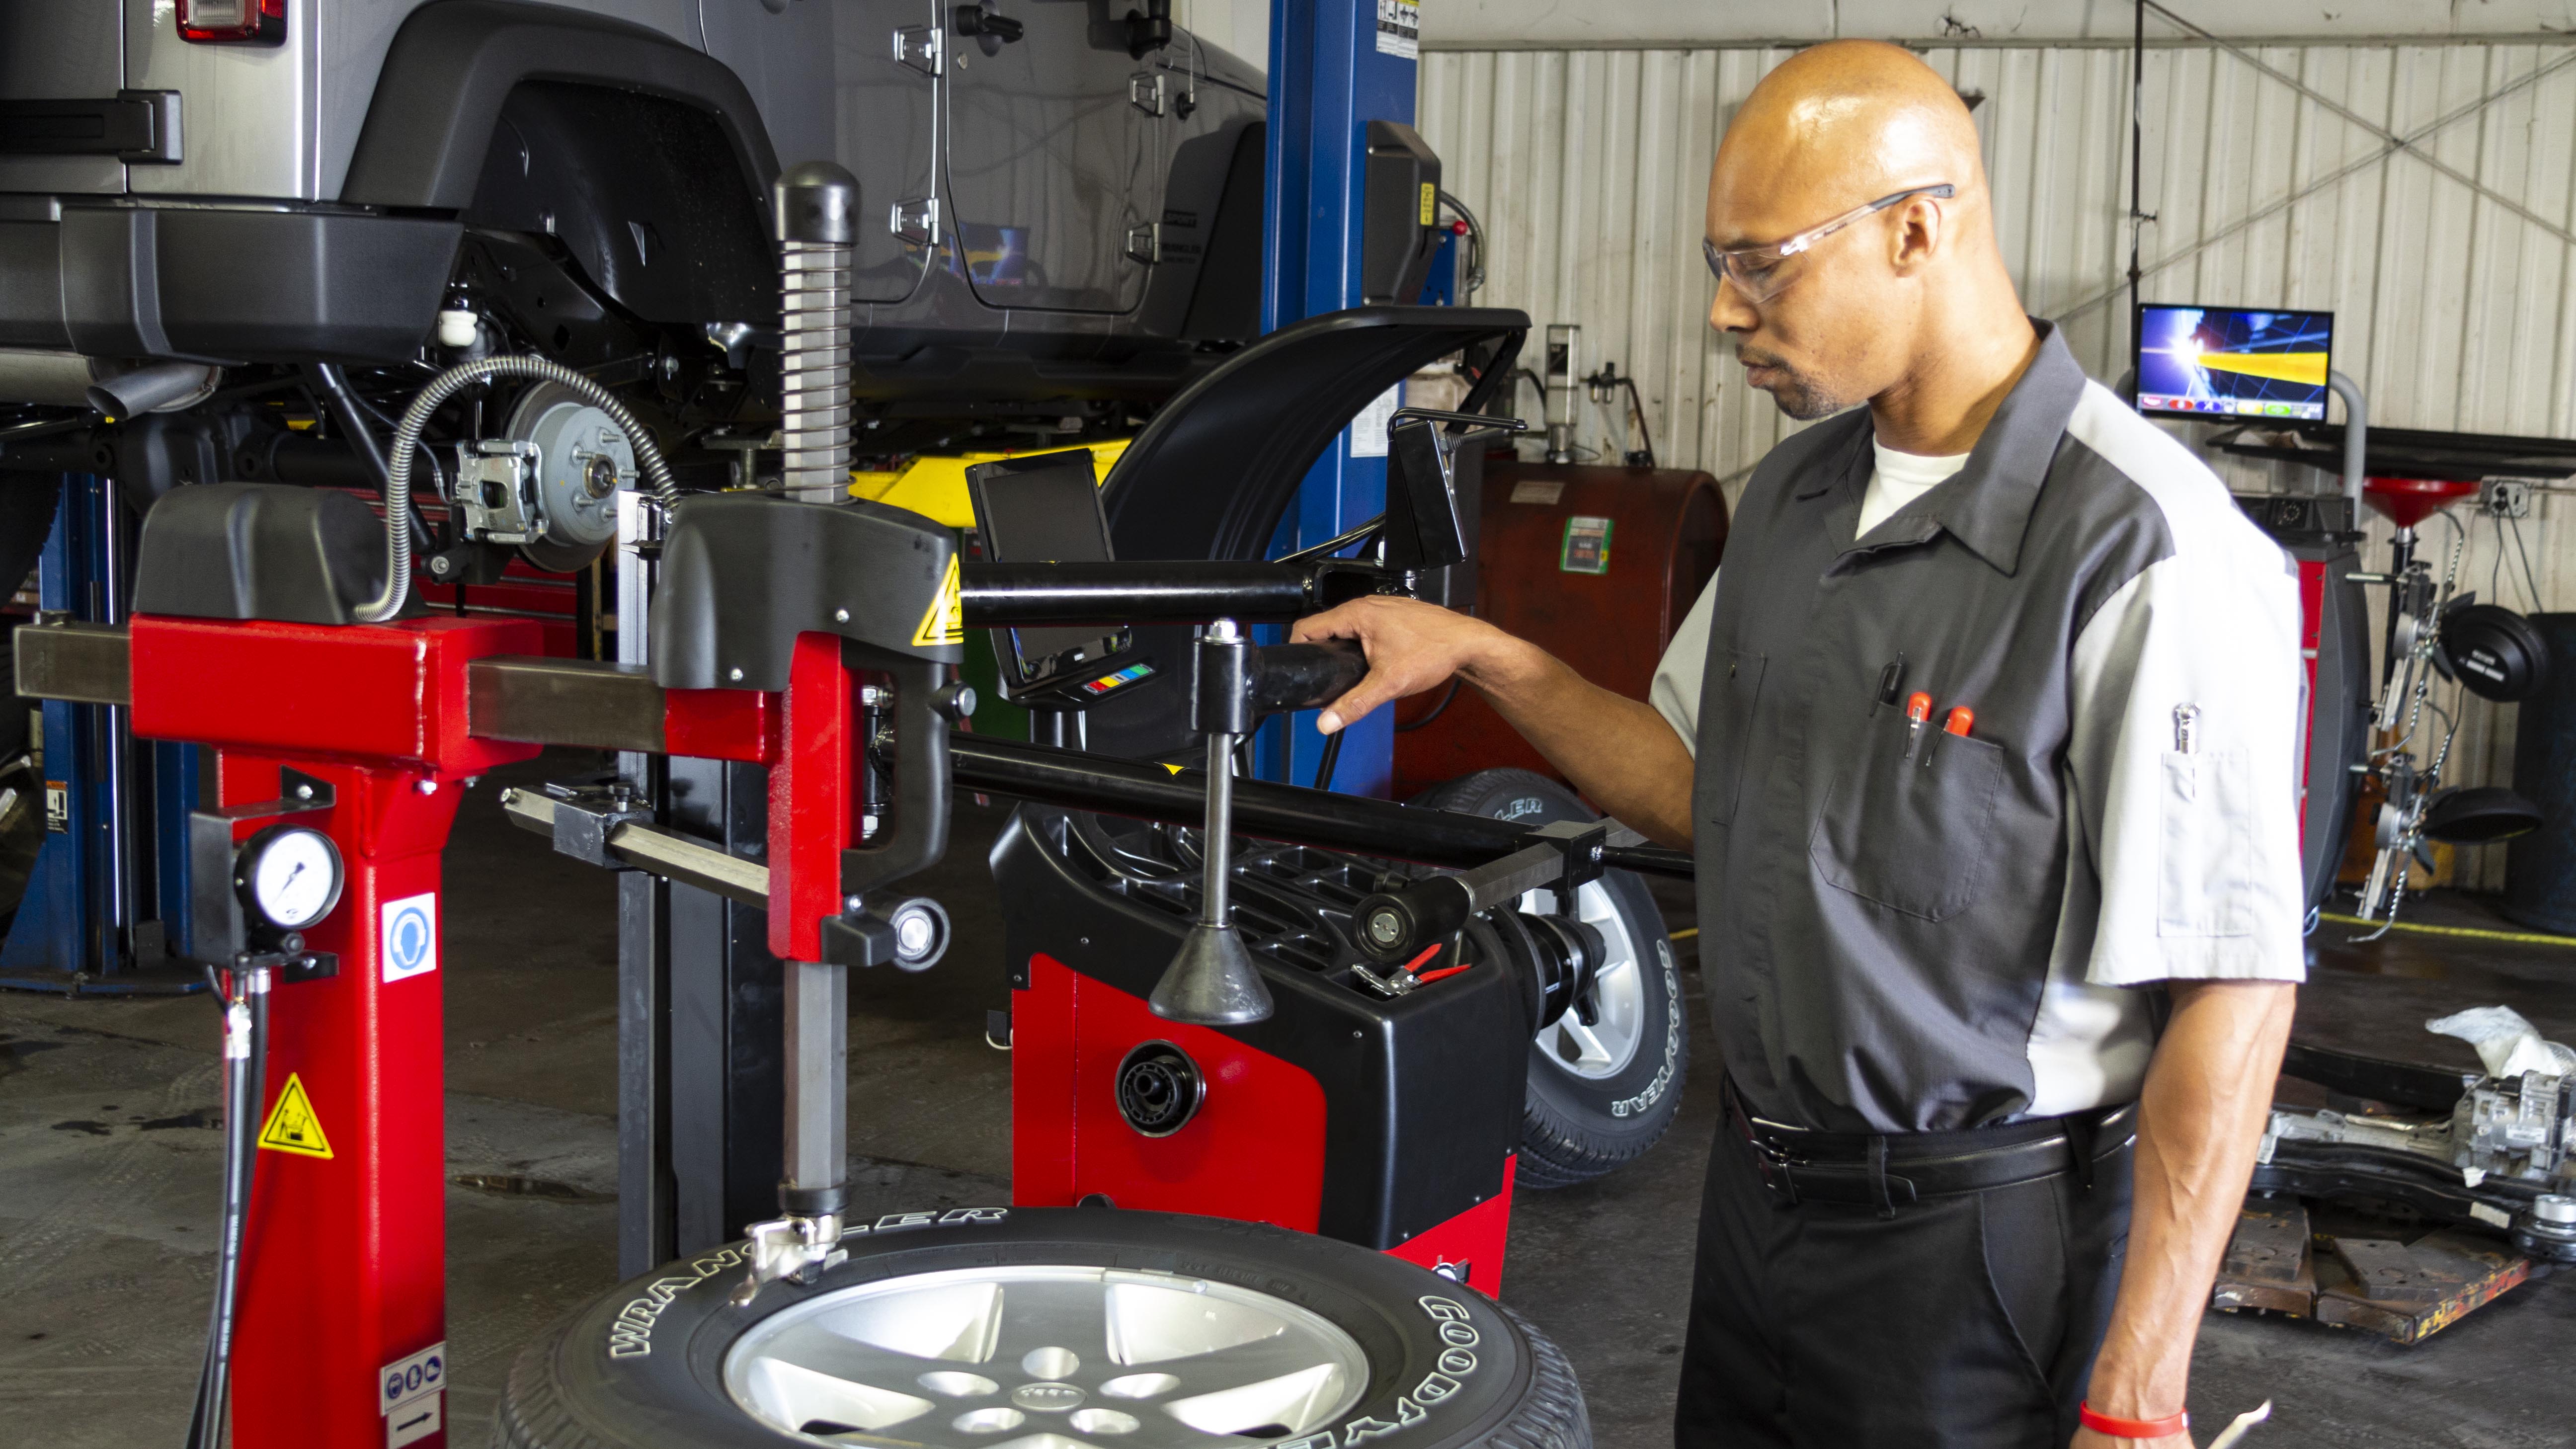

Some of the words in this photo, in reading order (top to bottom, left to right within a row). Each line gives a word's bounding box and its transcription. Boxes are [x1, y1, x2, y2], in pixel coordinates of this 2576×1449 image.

[1164, 212, 1197, 226] SPORT
[1494, 798, 1543, 821] LER
[1611, 939, 1680, 1117] GOODYEAR
[1255, 1295, 1479, 1449] GOODYE
